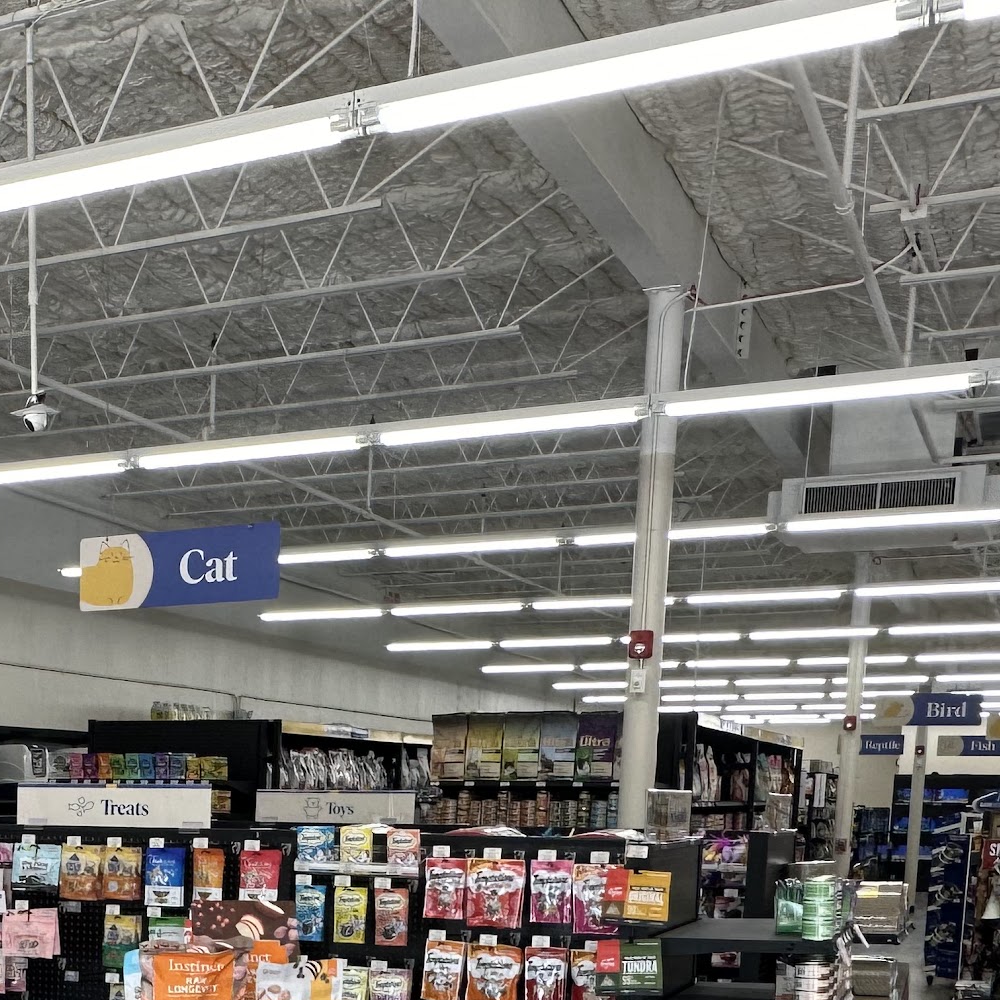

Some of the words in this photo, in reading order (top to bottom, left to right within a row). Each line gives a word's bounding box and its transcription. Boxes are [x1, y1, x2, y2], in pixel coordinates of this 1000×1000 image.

[180, 549, 238, 585] Cat
[926, 702, 966, 718] Bird
[101, 799, 149, 817] Treats
[327, 801, 354, 817] Toys
[168, 958, 226, 974] Instinct
[622, 960, 658, 974] TUNDRA
